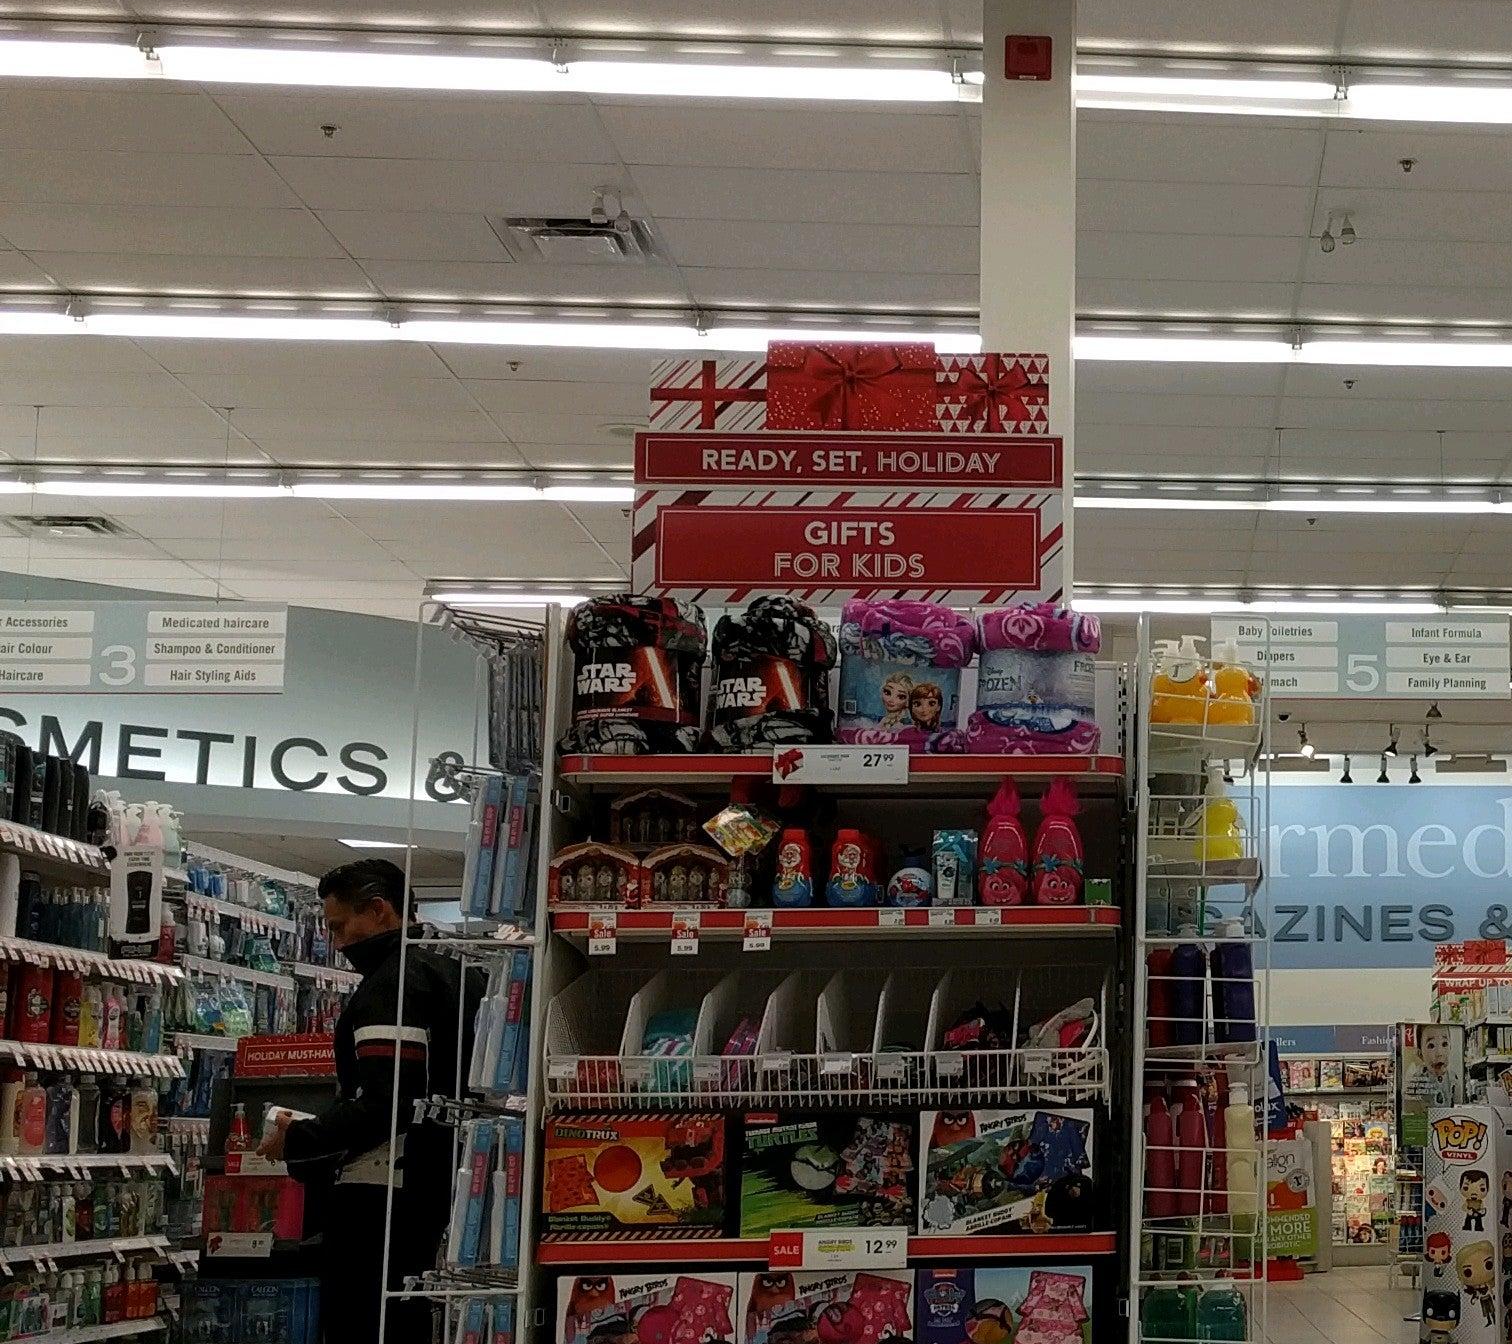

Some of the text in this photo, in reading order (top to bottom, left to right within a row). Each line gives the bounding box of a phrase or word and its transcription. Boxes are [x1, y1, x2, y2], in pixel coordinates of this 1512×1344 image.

[702, 449, 1001, 474] READY, SET, HOLIDAY
[804, 521, 896, 546] GIFTS
[774, 553, 925, 578] FOR KIDS
[6, 617, 68, 628] Accessories
[162, 617, 269, 629] Medicated haircare
[1238, 626, 1313, 638] Baby oiletries
[1411, 628, 1482, 639] Infant Formula
[18, 643, 54, 654] Colour
[154, 643, 275, 656] Shampoo & Conditioner
[99, 644, 136, 686] 3
[1423, 653, 1471, 665] Eye & Ear
[170, 670, 256, 683] Hair Styling Aids
[577, 663, 637, 681] STAR
[1346, 654, 1380, 692] 5
[576, 677, 637, 696] WARS
[718, 677, 767, 693] STAR
[1408, 678, 1487, 691] Family Planning
[1443, 978, 1477, 988] WRAP
[1479, 978, 1494, 988] UP
[247, 1048, 335, 1062] HOLIDAY MUST-HAV
[979, 1113, 1028, 1135] ANGRY BIRDS
[554, 1127, 619, 1141] DINOTRUX
[1432, 1118, 1489, 1151] POP!
[1446, 1151, 1474, 1159] VINYL
[1270, 1221, 1312, 1235] MORE
[773, 1244, 800, 1256] SALE
[798, 1274, 848, 1296] ANGRY BIRDS
[619, 1285, 644, 1300] ANGRY
